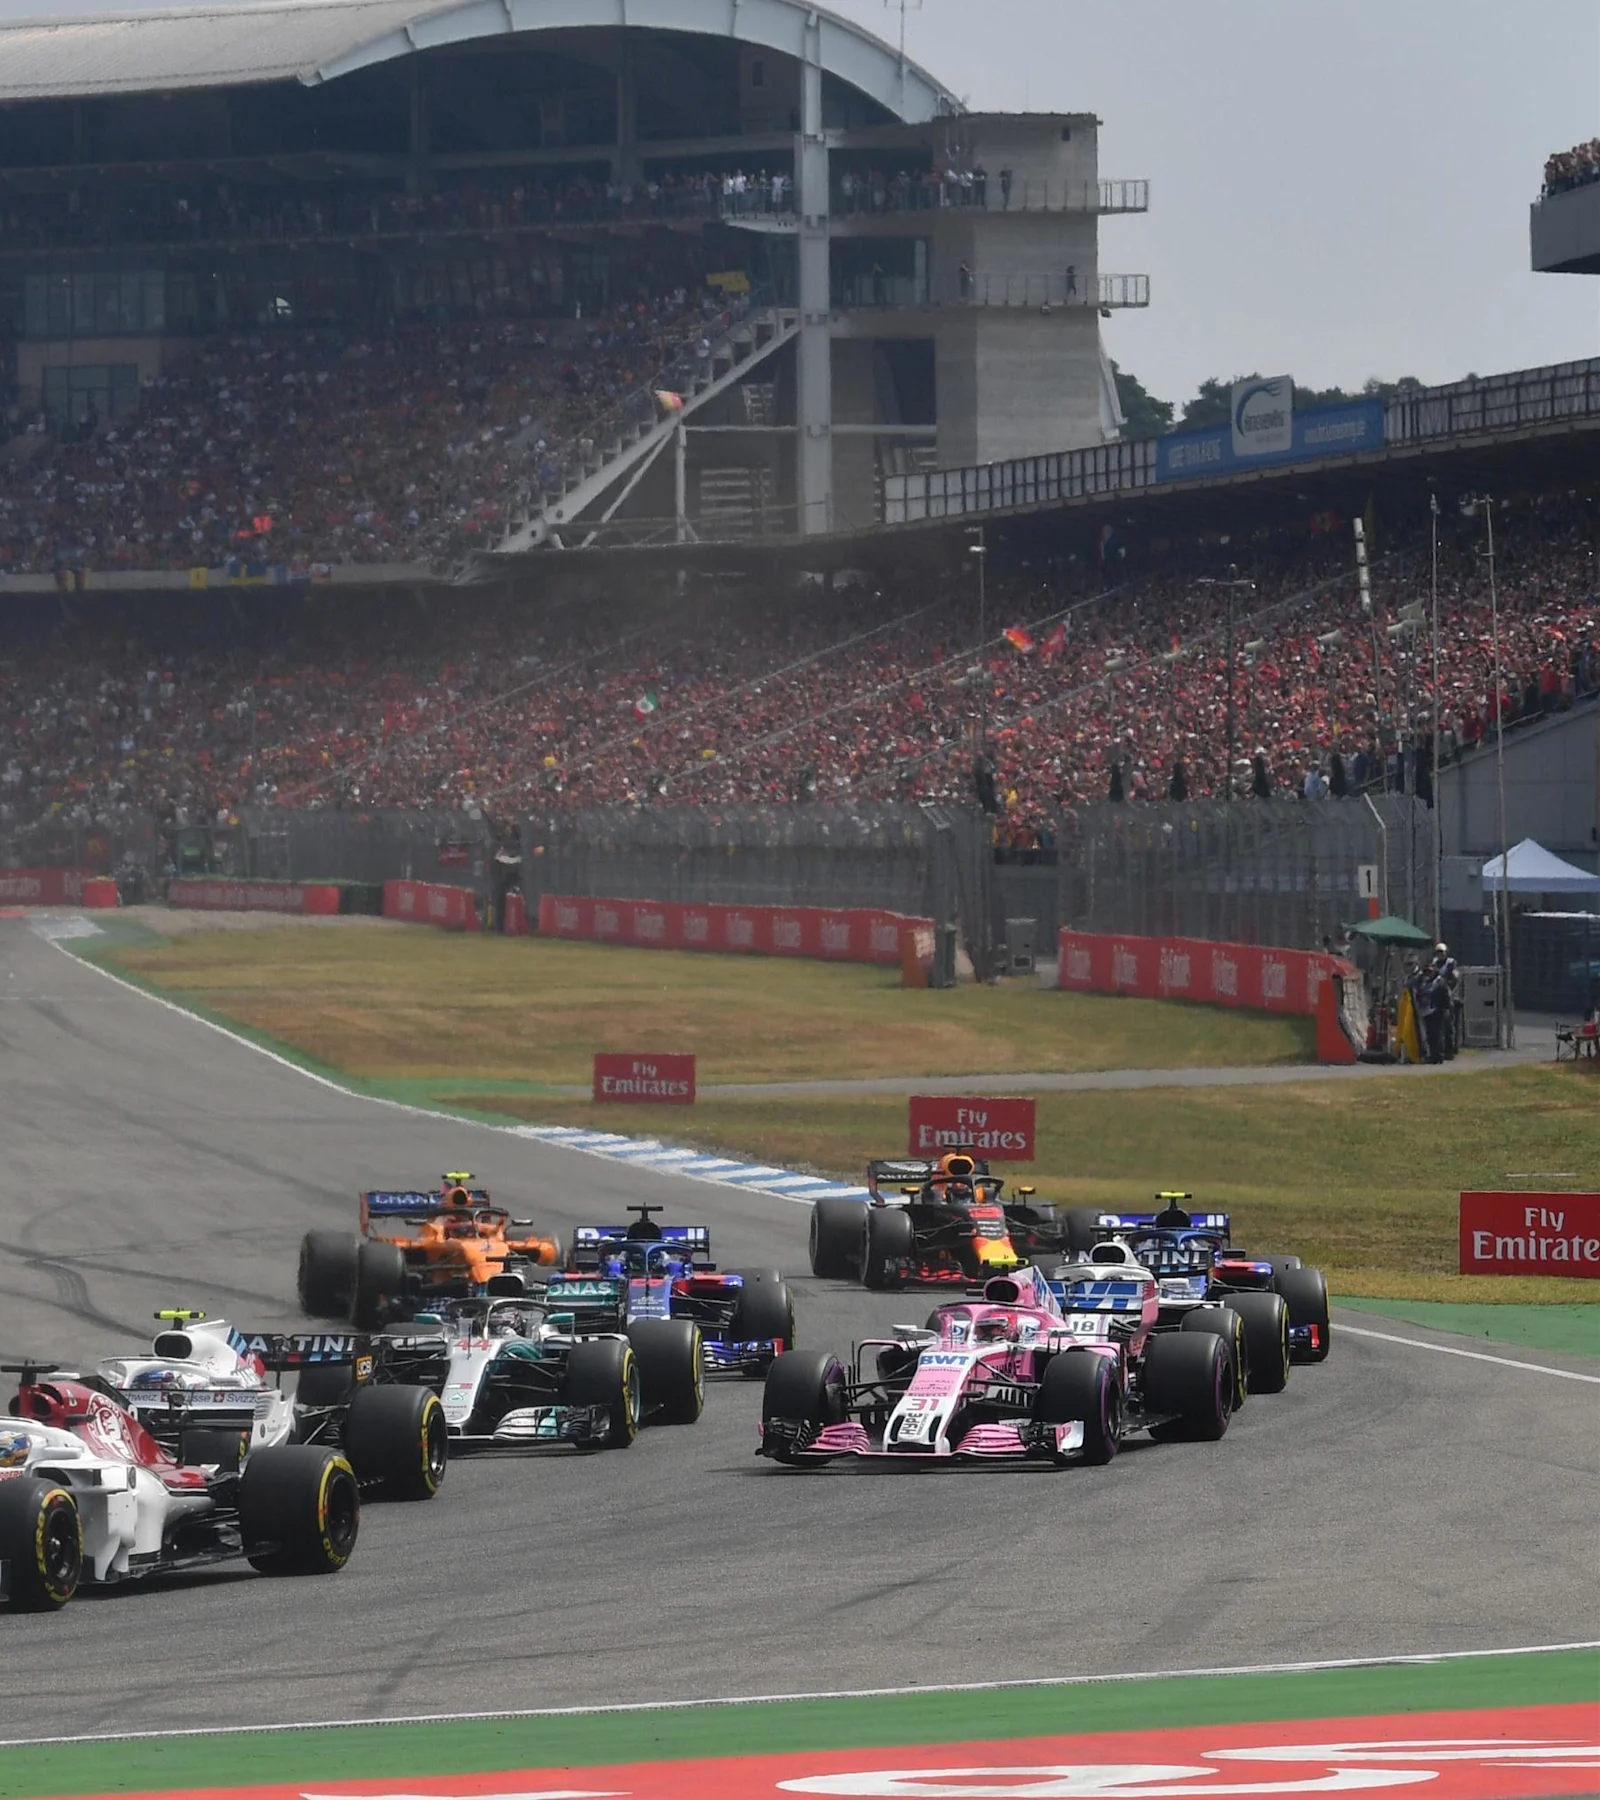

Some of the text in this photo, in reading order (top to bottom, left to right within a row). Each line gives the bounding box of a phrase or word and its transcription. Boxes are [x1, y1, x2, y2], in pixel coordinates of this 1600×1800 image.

[1363, 869, 1372, 893] 1
[633, 1061, 657, 1078] Fly
[600, 1075, 689, 1097] Emirates
[957, 1107, 988, 1128] Fly
[919, 1124, 1027, 1150] Emirates
[1524, 1206, 1565, 1232] Fly
[1472, 1229, 1600, 1262] Emirate
[547, 1281, 612, 1297] ONAS
[454, 1339, 492, 1351] 44
[919, 1354, 970, 1366] BWT
[908, 1399, 940, 1412] 31
[900, 1412, 923, 1436] HYPE
